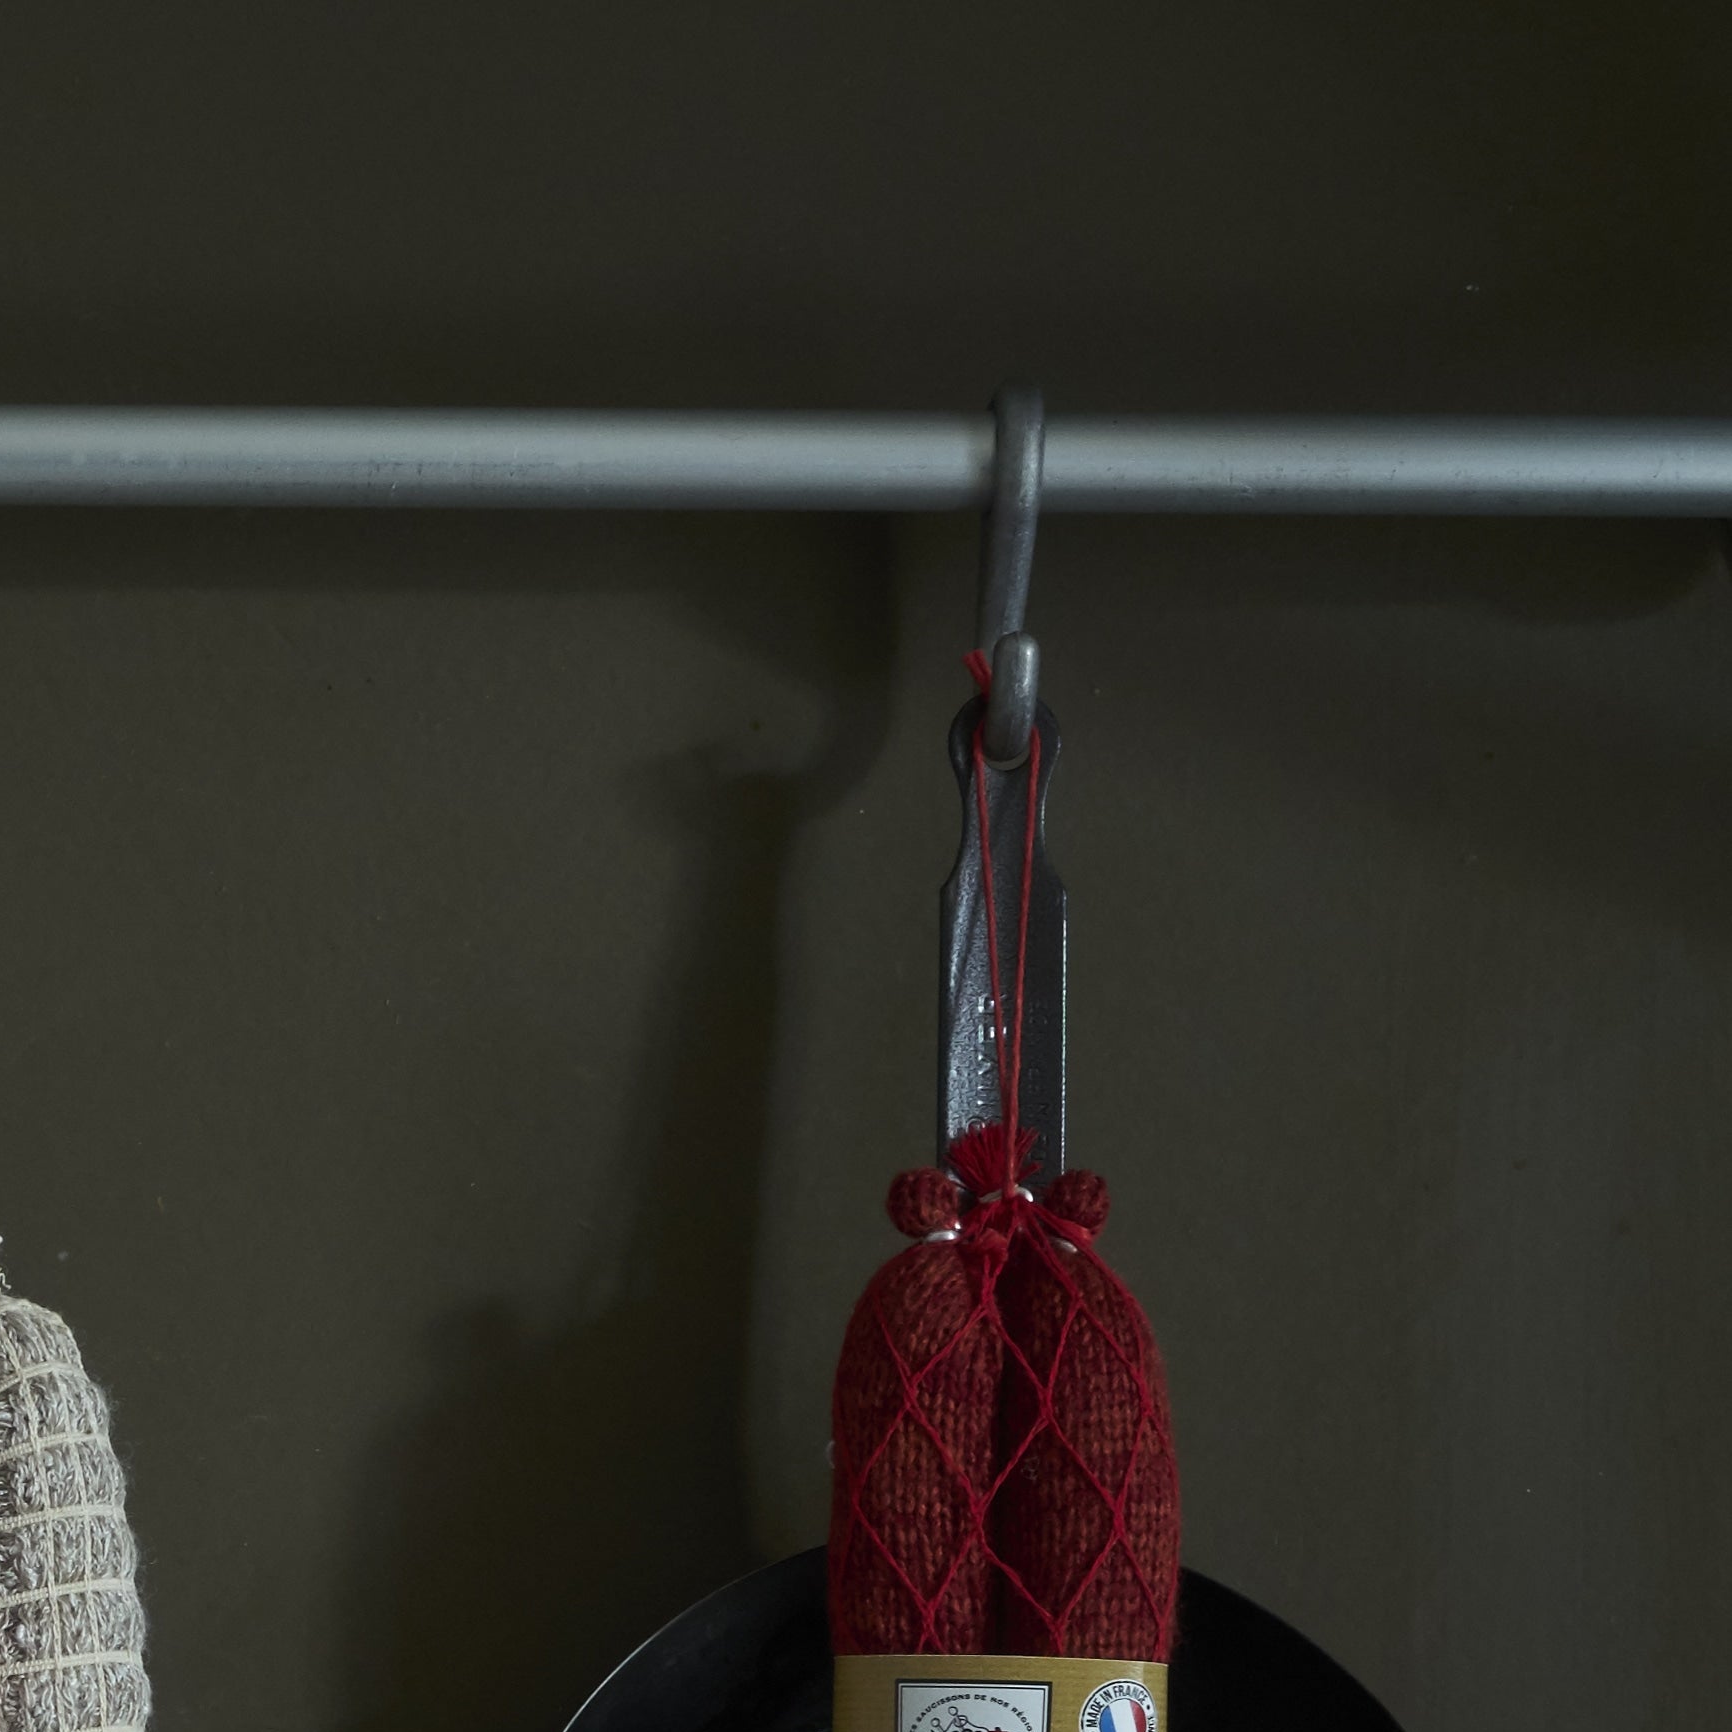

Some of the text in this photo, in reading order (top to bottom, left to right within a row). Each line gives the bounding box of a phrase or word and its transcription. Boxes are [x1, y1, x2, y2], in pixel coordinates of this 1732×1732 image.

[916, 1694, 971, 1722] SAUCISSONS
[990, 1697, 1010, 1708] NOS
[1086, 1685, 1149, 1728] MADE IN FRANCE
